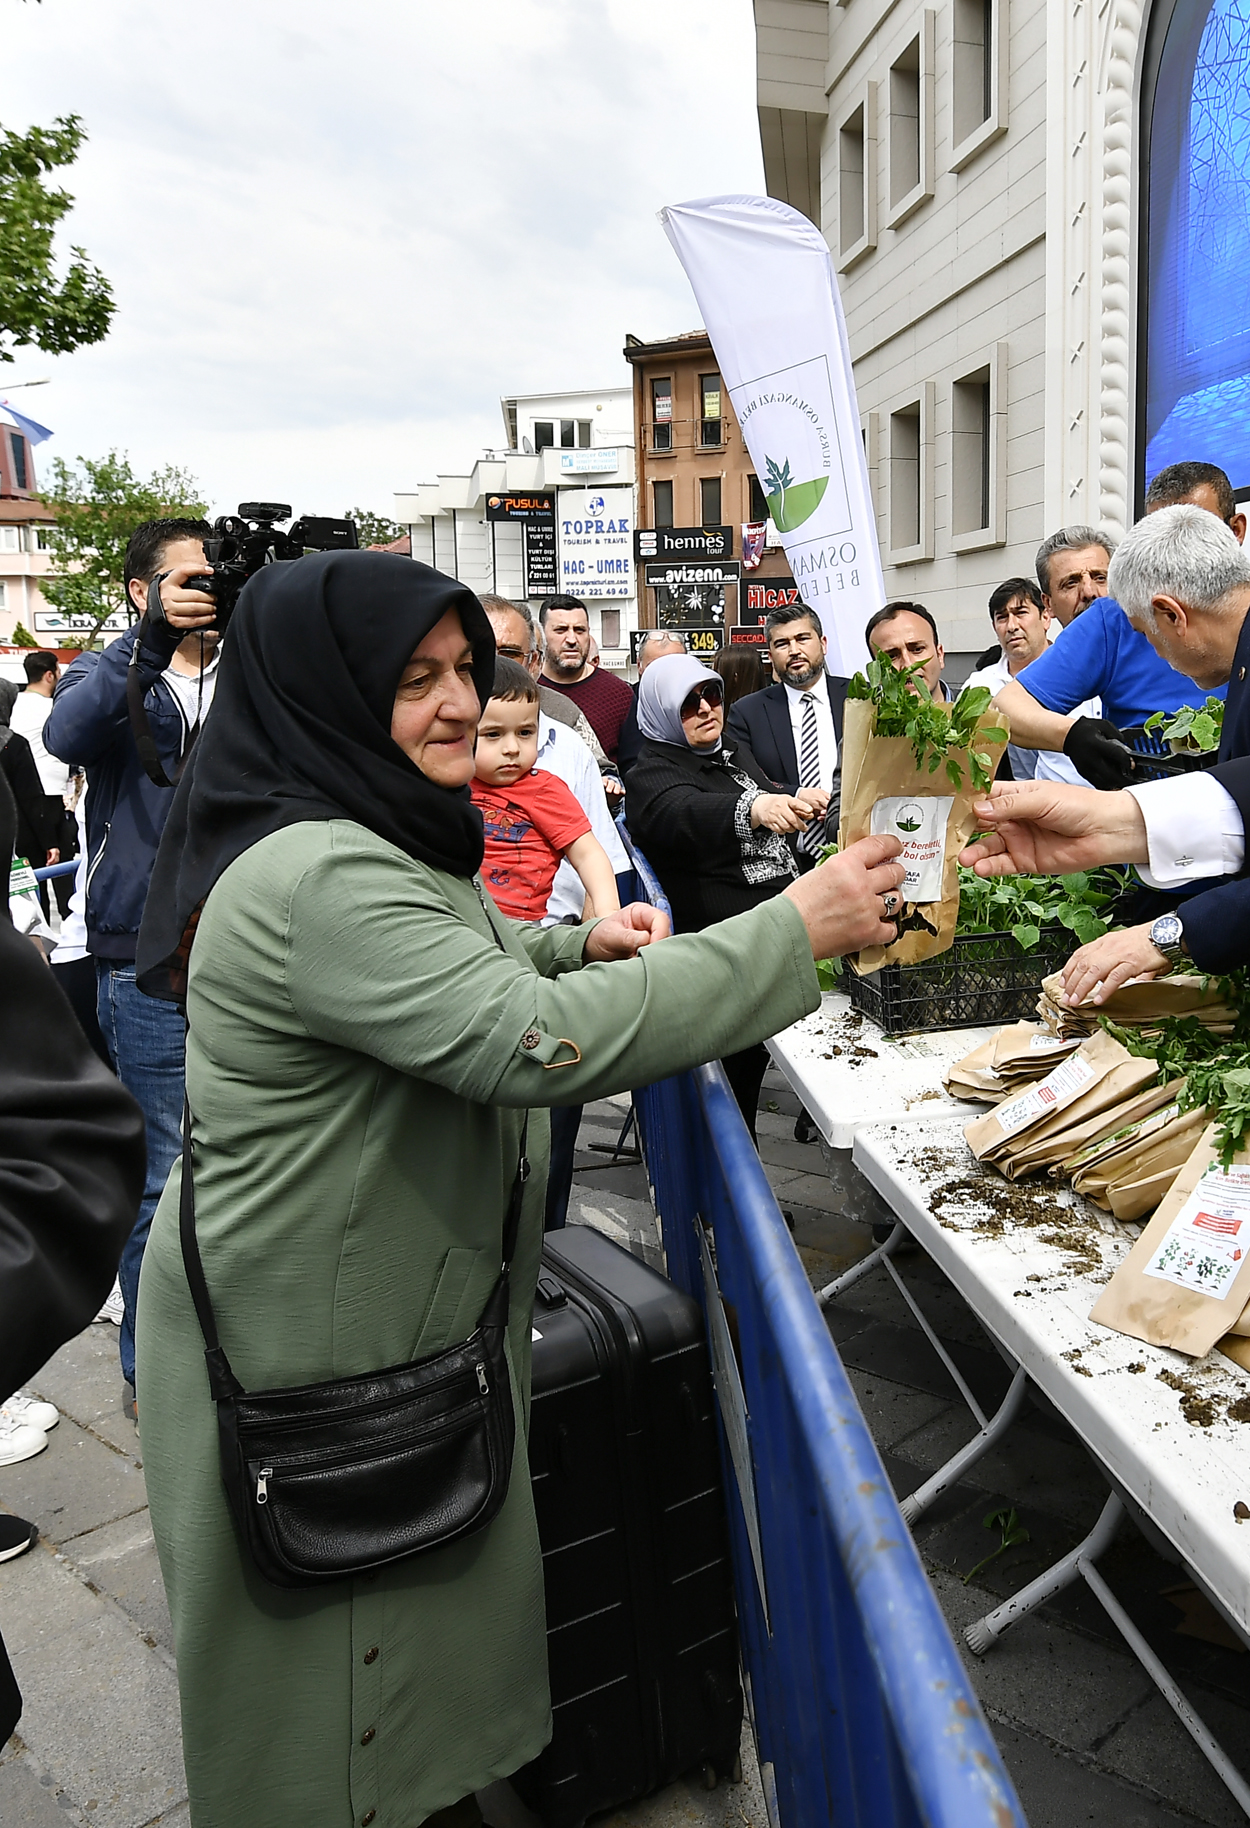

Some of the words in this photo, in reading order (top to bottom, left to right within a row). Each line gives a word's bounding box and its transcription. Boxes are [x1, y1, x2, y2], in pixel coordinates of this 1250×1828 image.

[503, 498, 551, 512] PUSULA
[562, 518, 630, 535] TOPRAK
[663, 534, 724, 549] hennes
[563, 560, 585, 574] HAC
[597, 559, 629, 574] UMRE
[648, 565, 738, 583] www.avizenn.com
[565, 588, 585, 596] 0224
[903, 850, 919, 860] bol
[905, 870, 921, 878] TAFA
